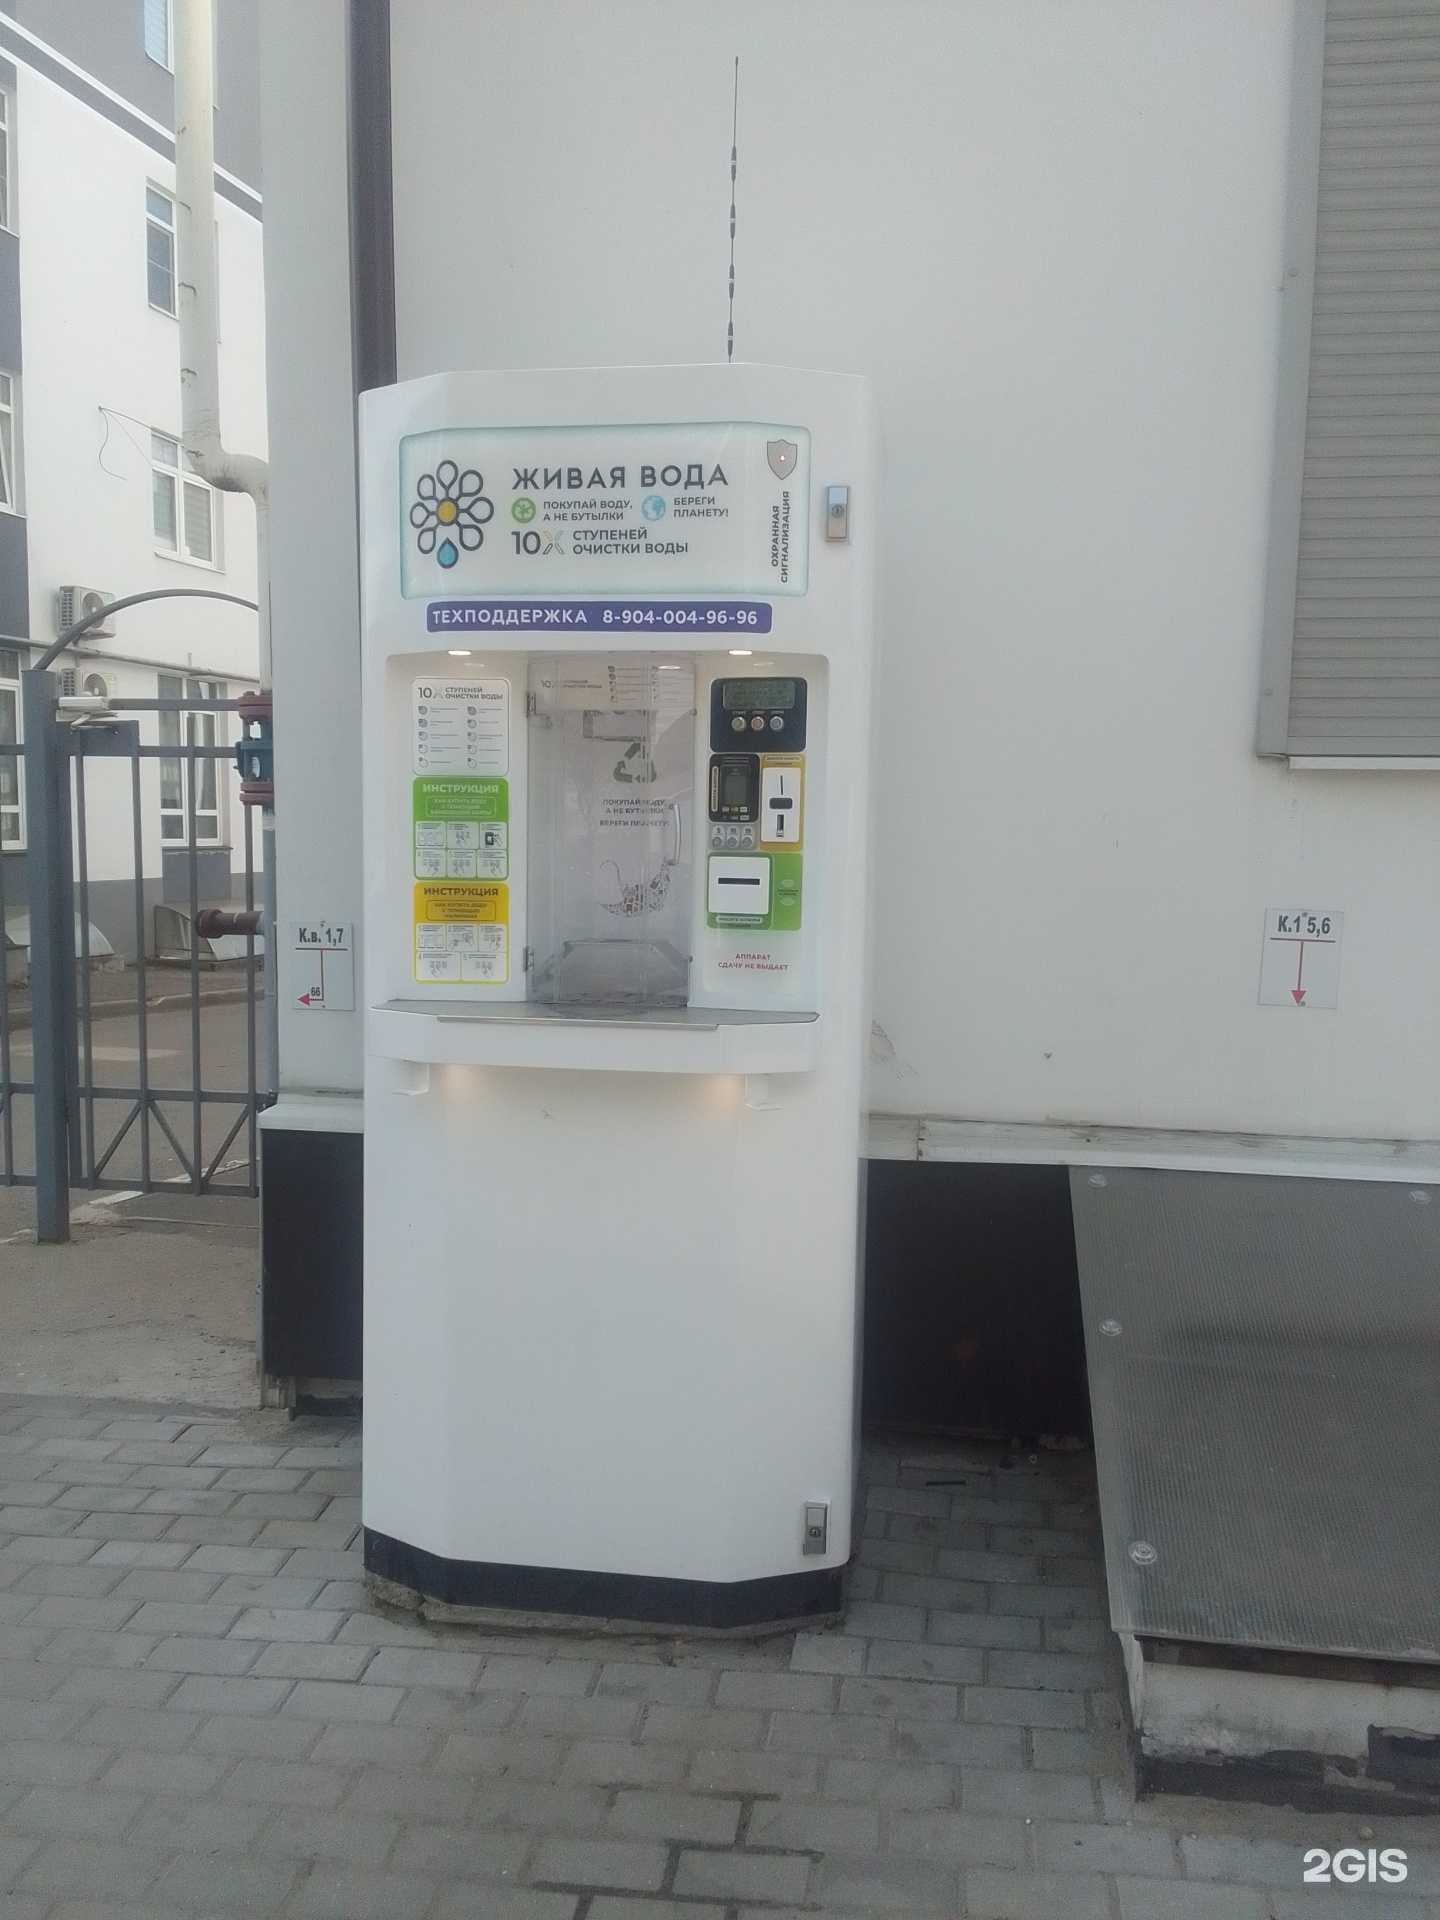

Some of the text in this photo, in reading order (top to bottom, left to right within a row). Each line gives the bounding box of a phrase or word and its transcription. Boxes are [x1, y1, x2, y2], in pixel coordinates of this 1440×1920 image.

[512, 463, 729, 490] ЖИВАЯ ВОДА
[543, 499, 633, 510] ПОКУПАЙ ВОДУ,
[673, 496, 715, 506] БЕРЕГИ
[543, 512, 624, 521] А НЕ БУТЫЛКИ
[673, 508, 729, 518] ПЛАНЕТУ!
[572, 527, 648, 541] СТУПЕНЕЙ
[771, 505, 780, 567] ОХРАННАЯ
[780, 490, 791, 584] СИГНАЛИЗАЦИЯ
[572, 542, 688, 555] ОЧИСТКИ ВОДЫ
[432, 608, 758, 626] ТЕХПОДДЕРЖКА 8-904-004-96-96
[422, 783, 500, 794] ИНСТРУКЦИЯ
[423, 887, 499, 897] ИНСТРУКЦИЯ
[1306, 916, 1331, 938] 5,6
[325, 927, 344, 946] 1,7
[735, 952, 771, 961] АППАРАТ
[311, 986, 321, 997] 66
